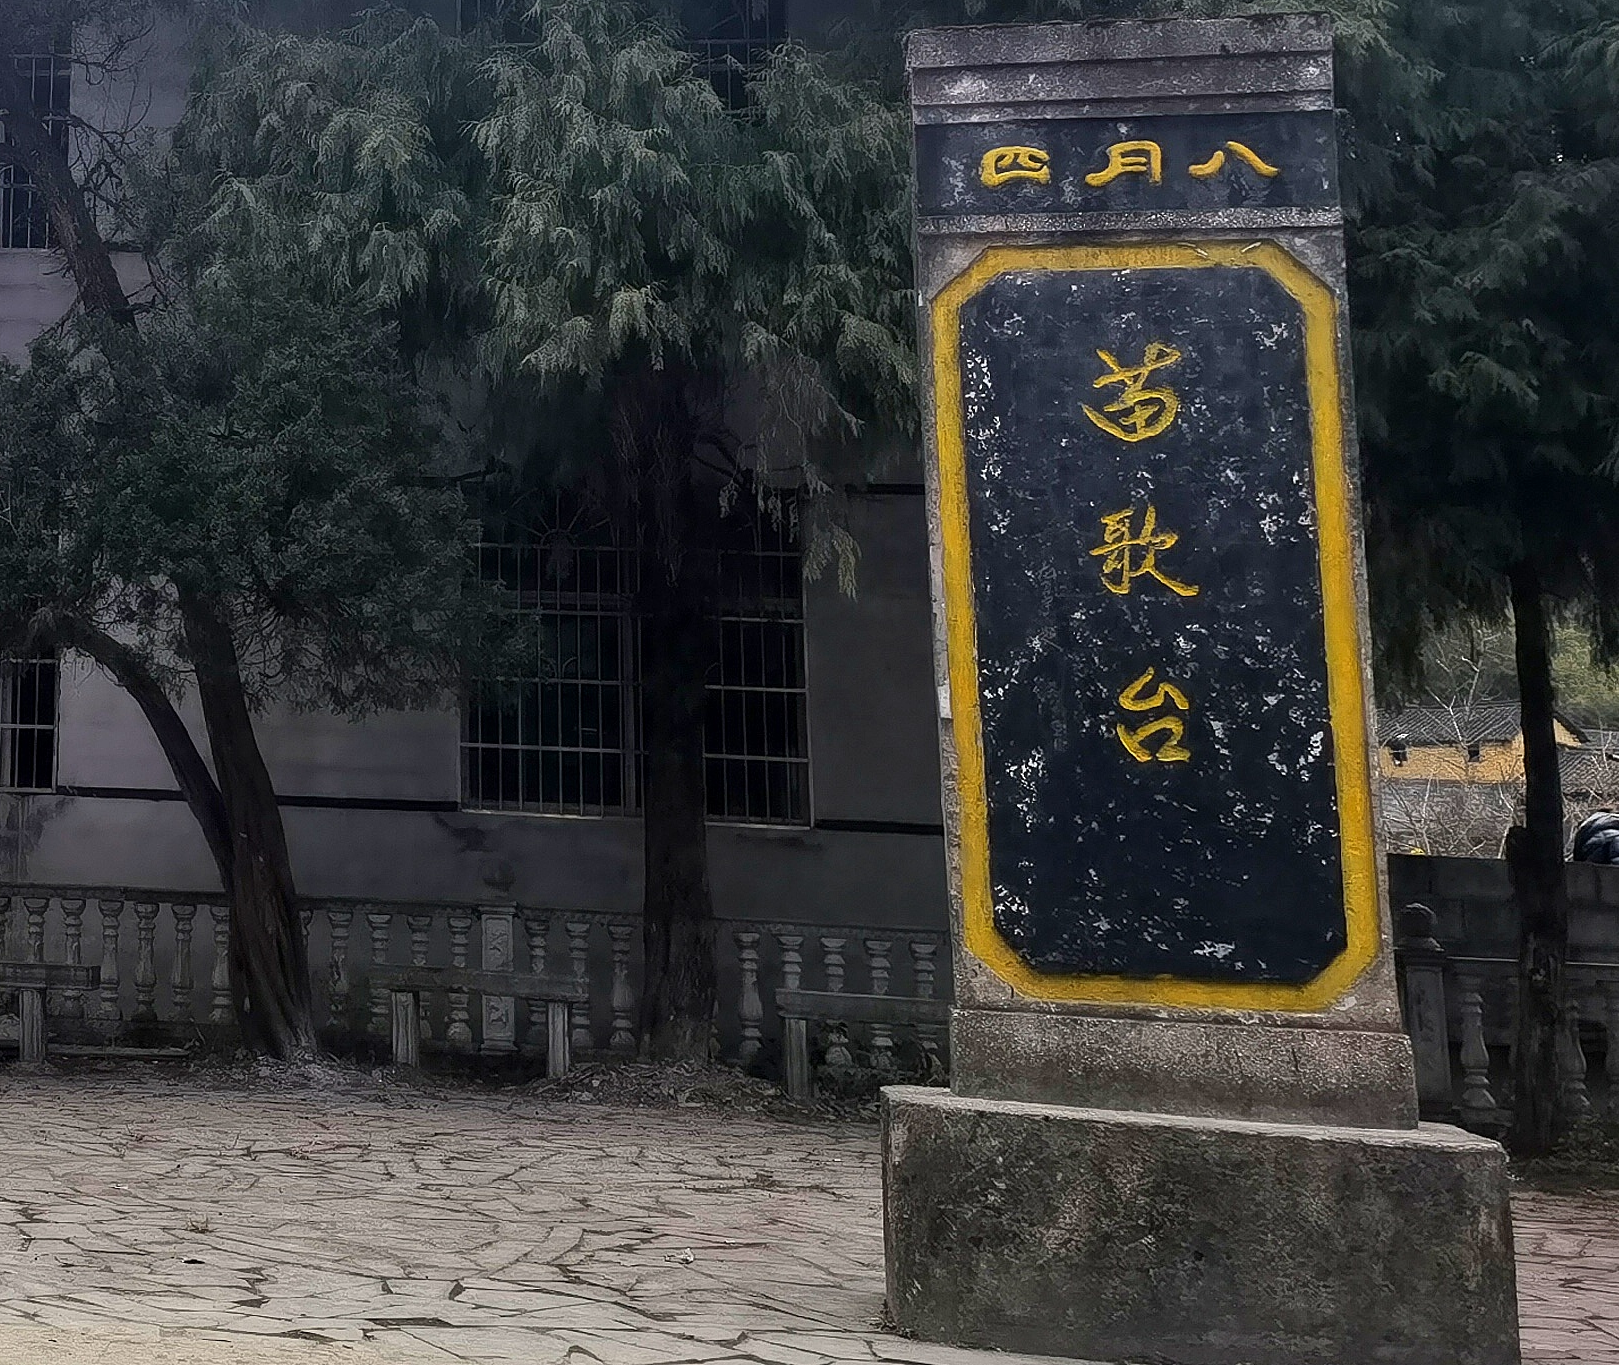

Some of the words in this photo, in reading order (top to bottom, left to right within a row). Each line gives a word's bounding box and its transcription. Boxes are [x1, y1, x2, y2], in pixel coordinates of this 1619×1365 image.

[979, 139, 1279, 188] 四月八
[1082, 341, 1200, 764] 苗歌台
